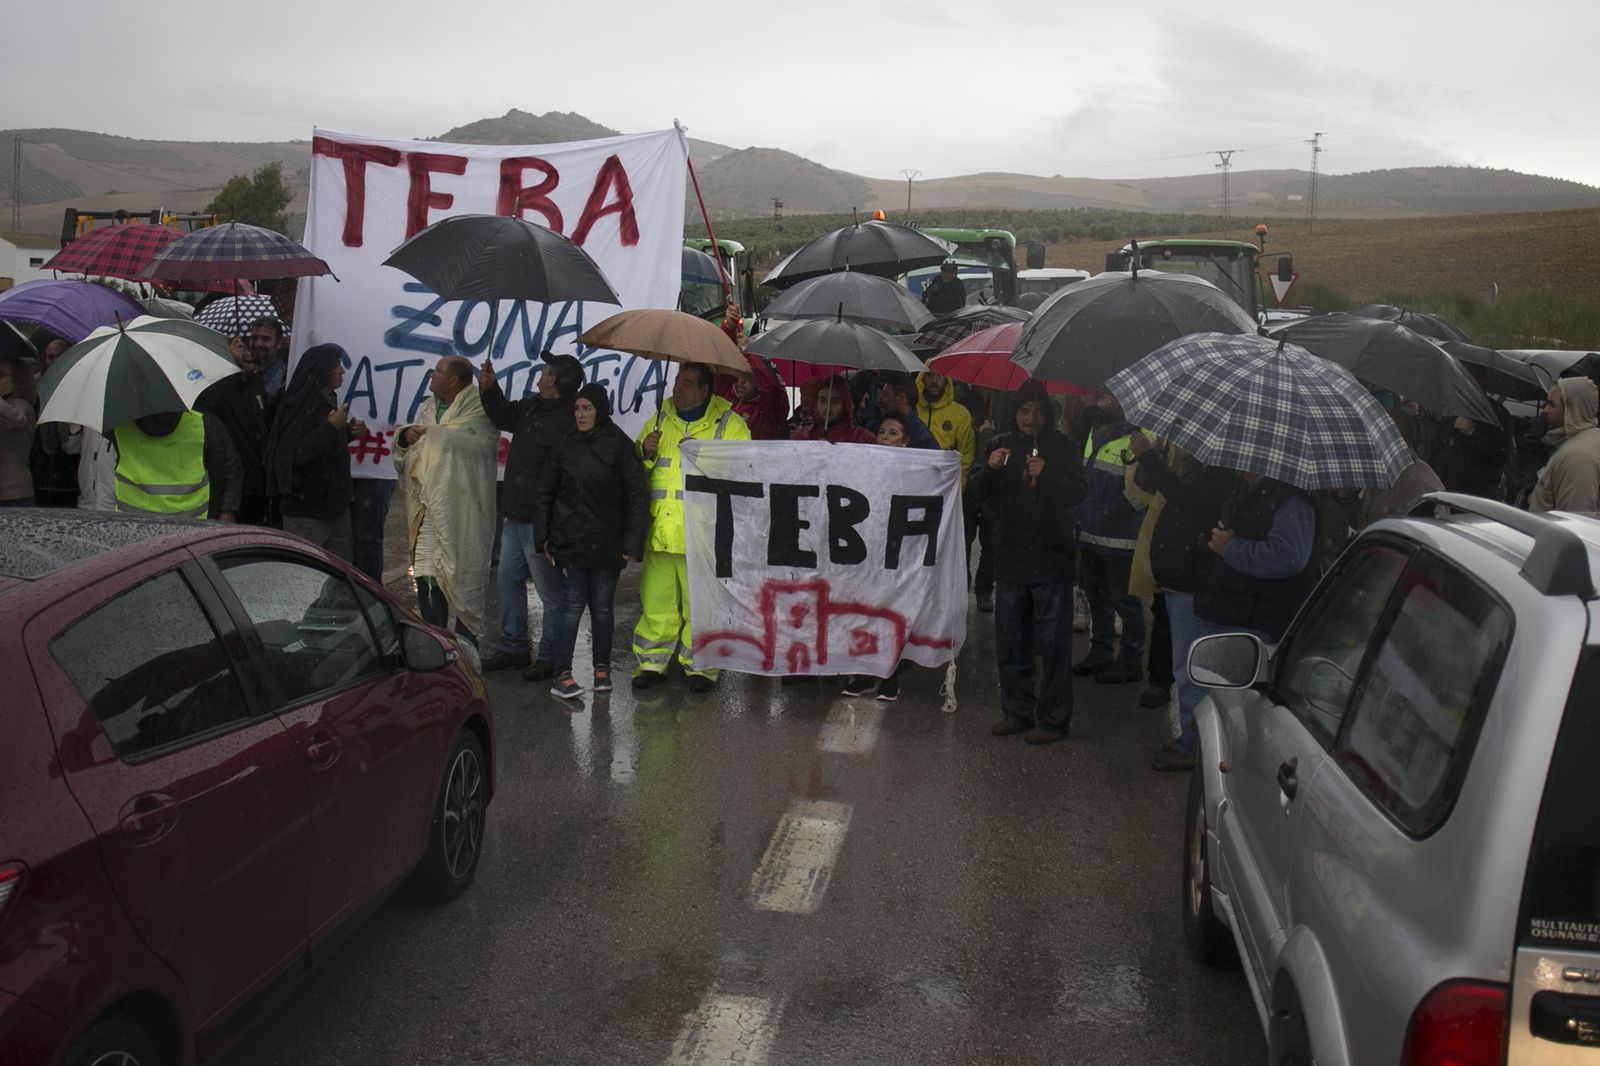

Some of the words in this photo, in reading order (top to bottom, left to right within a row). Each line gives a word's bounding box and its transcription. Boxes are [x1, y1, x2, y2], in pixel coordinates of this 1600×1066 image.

[312, 136, 639, 248] TEBA
[384, 282, 584, 360] ZONA
[685, 474, 944, 578] TEBA
[1531, 928, 1574, 940] OSUNA
